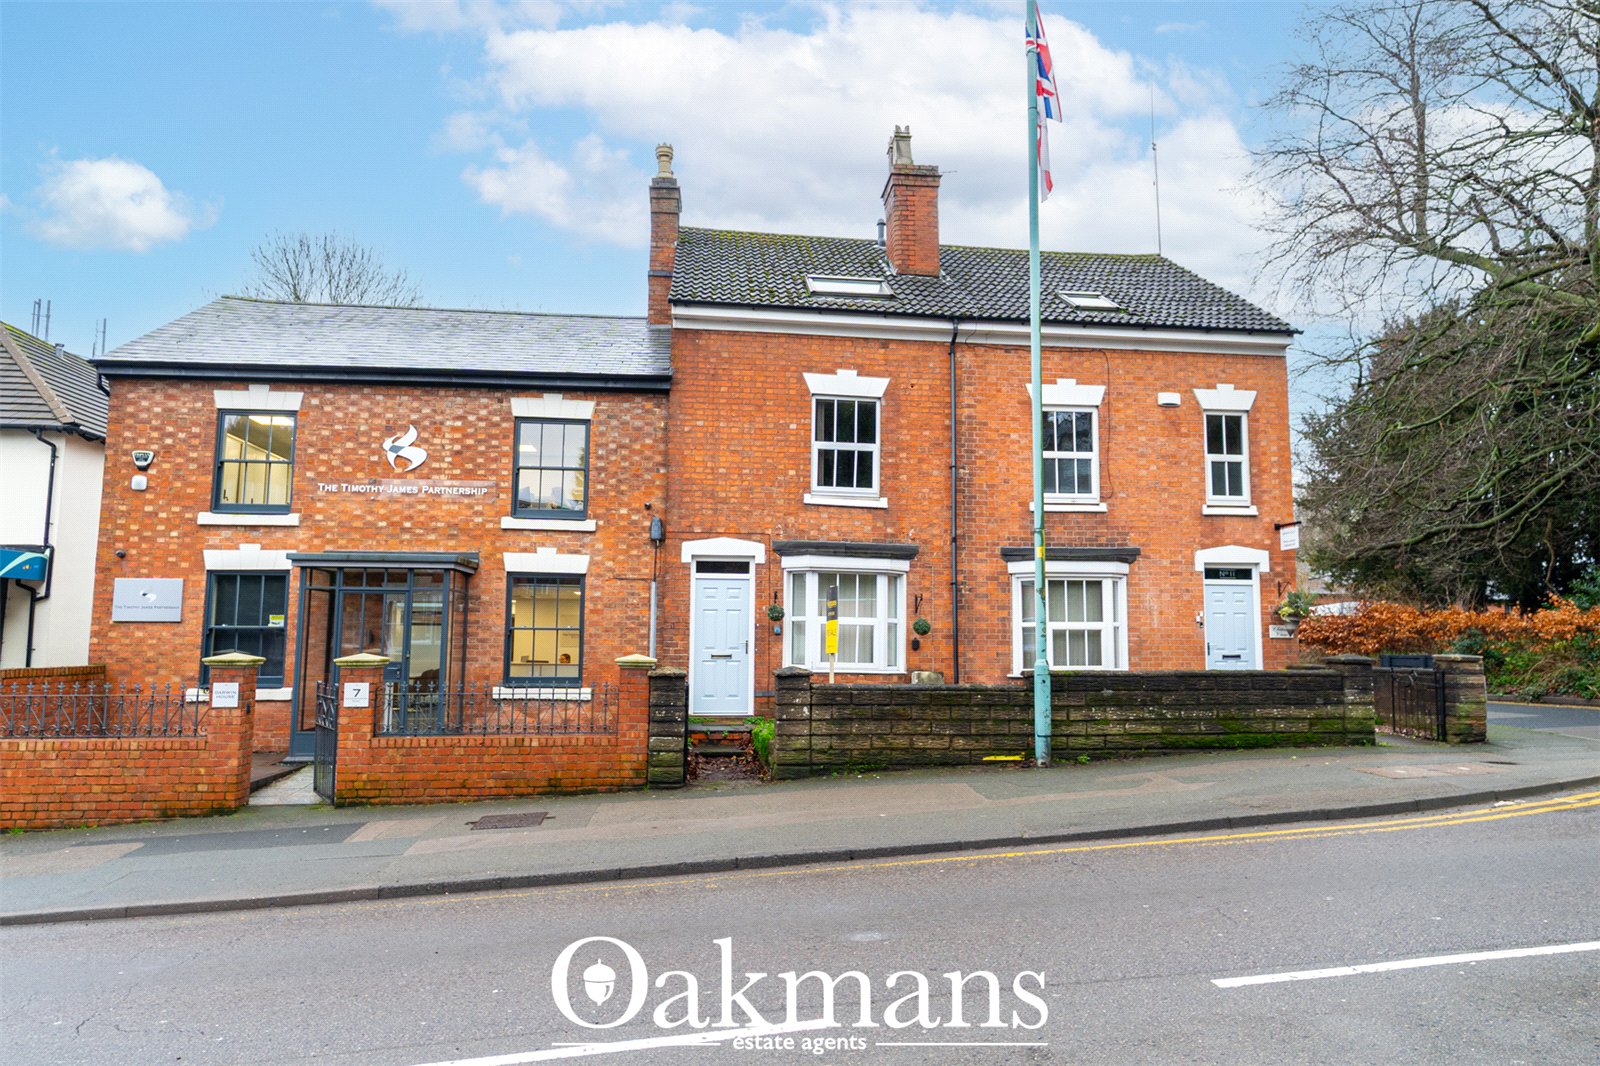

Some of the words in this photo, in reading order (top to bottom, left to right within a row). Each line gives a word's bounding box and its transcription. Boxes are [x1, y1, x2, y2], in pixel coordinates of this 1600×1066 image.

[318, 482, 338, 492] THE
[341, 483, 385, 493] TIMOTHY
[387, 485, 418, 494] JAMES
[422, 485, 488, 495] PARTNERSHIP
[352, 688, 361, 698] 7
